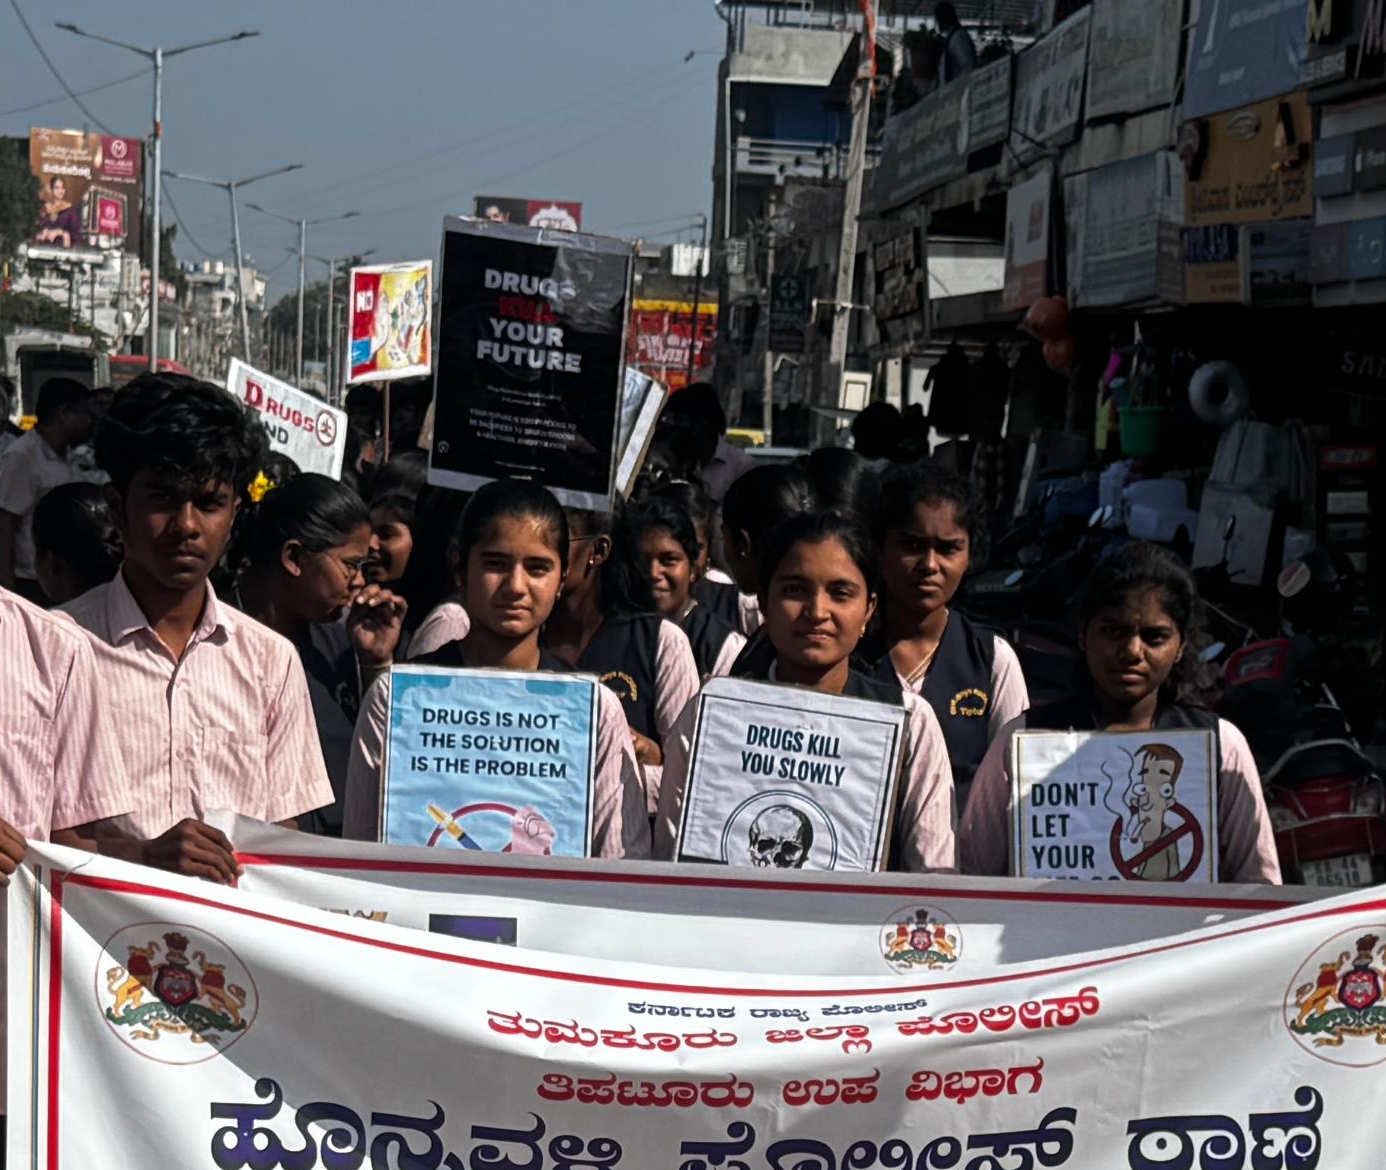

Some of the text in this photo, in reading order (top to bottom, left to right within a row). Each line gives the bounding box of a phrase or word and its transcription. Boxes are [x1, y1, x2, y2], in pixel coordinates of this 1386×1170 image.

[484, 267, 577, 300] DRUGS
[356, 289, 374, 313] NO
[489, 316, 565, 348] YOUR
[475, 339, 583, 374] FUTURE
[243, 377, 315, 433] DRUGS
[264, 421, 290, 445] ND
[422, 707, 561, 731] DRUGS IS NOT
[419, 731, 561, 755] THE SOLUTION
[746, 723, 842, 760] DRUGS KILL
[410, 755, 567, 780] IS THE PROBLEM
[740, 750, 846, 788] YOU SLOWLY
[1031, 781, 1100, 807] DON'T
[1031, 813, 1071, 838] LET
[1031, 844, 1096, 869] YOUR
[485, 984, 1102, 1054] ತುಮಕೂರು ಜಿಲ್ಲಾ ಪೊಲೀಸ್
[627, 1000, 736, 1019] ಕರ್ನಾಟಕ
[750, 1004, 811, 1022] ರಾಜ್ಯ
[535, 1054, 1046, 1109] ತಿಪಟೂರು ಉಪ ವಿಭಾಗ
